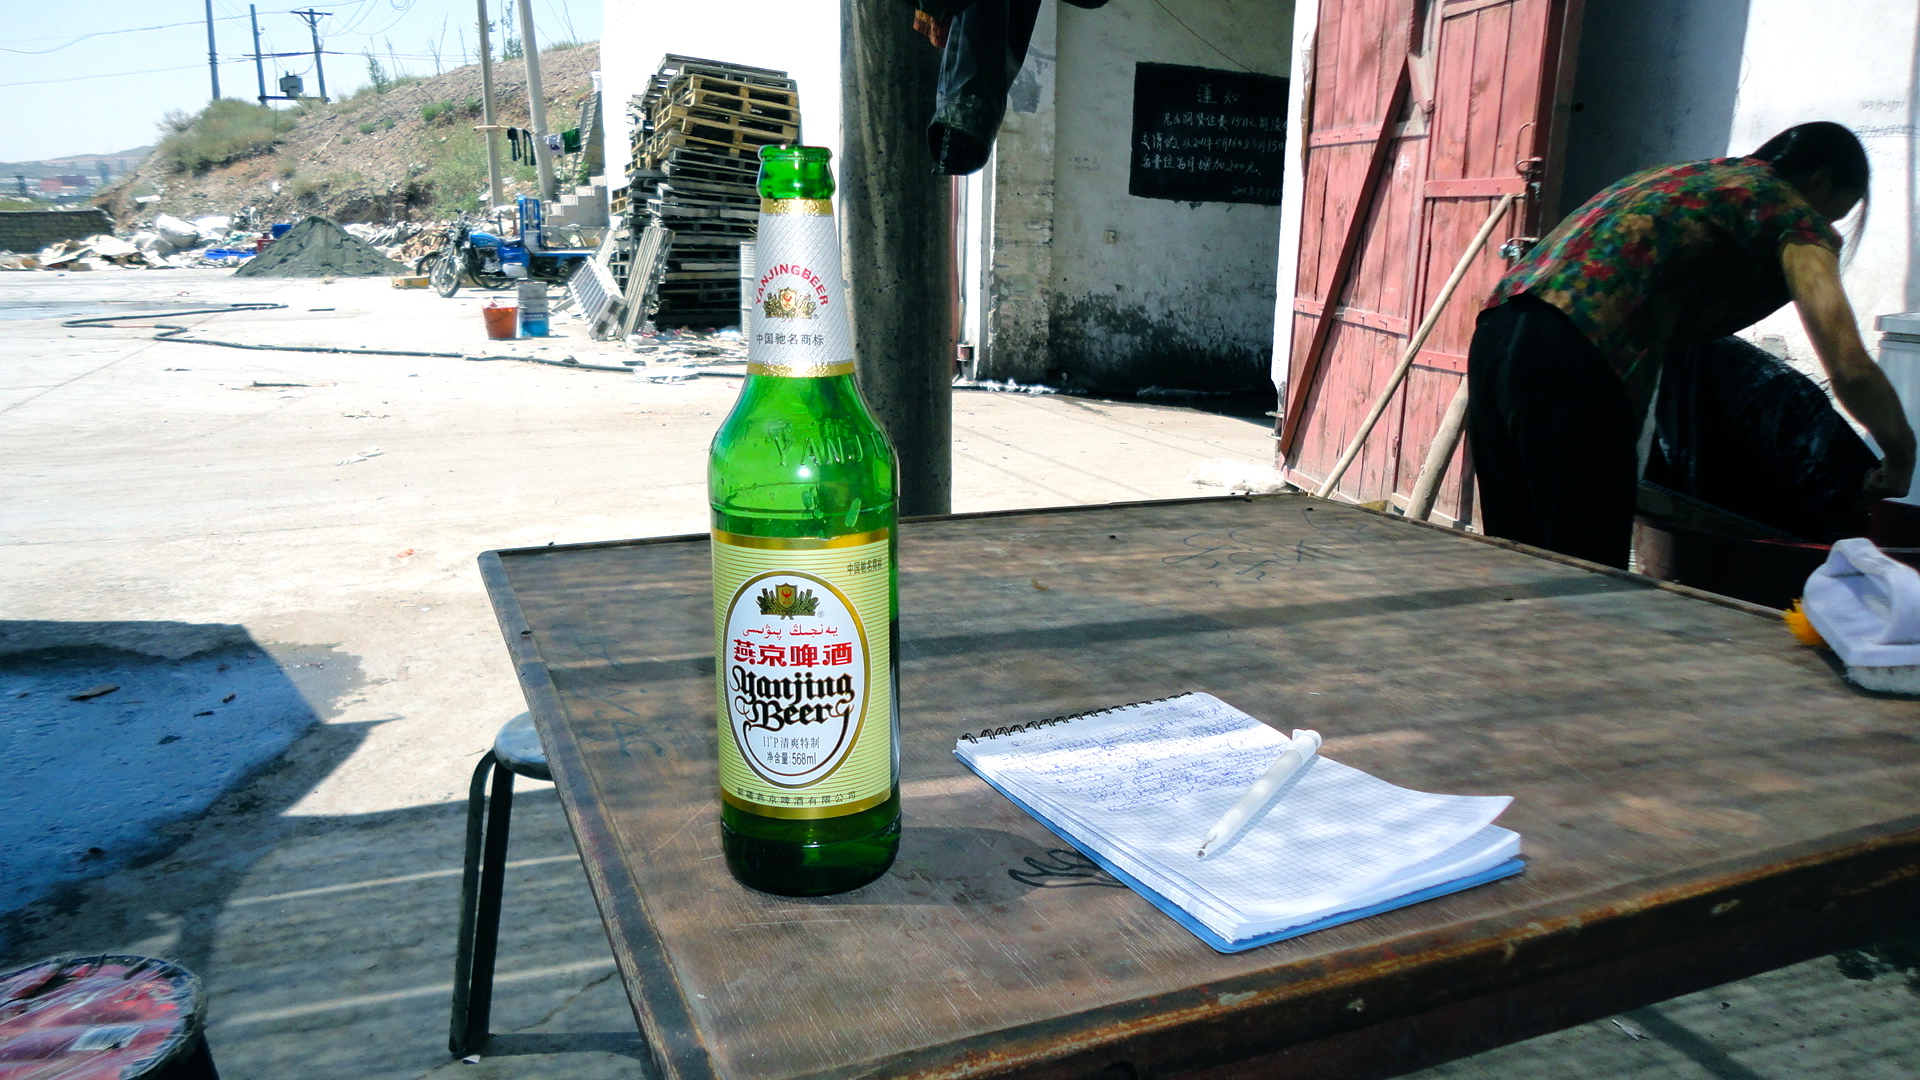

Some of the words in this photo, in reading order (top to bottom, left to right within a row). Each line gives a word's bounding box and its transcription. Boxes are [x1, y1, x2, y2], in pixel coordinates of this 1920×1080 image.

[1197, 83, 1240, 105] 通知
[756, 332, 824, 346] 中国驰名商标
[733, 638, 853, 668] 燕京啤酒
[730, 665, 855, 705] Yanjing
[736, 696, 852, 732] Beer
[737, 787, 856, 806] 新疆燕京啤酒有限公司
